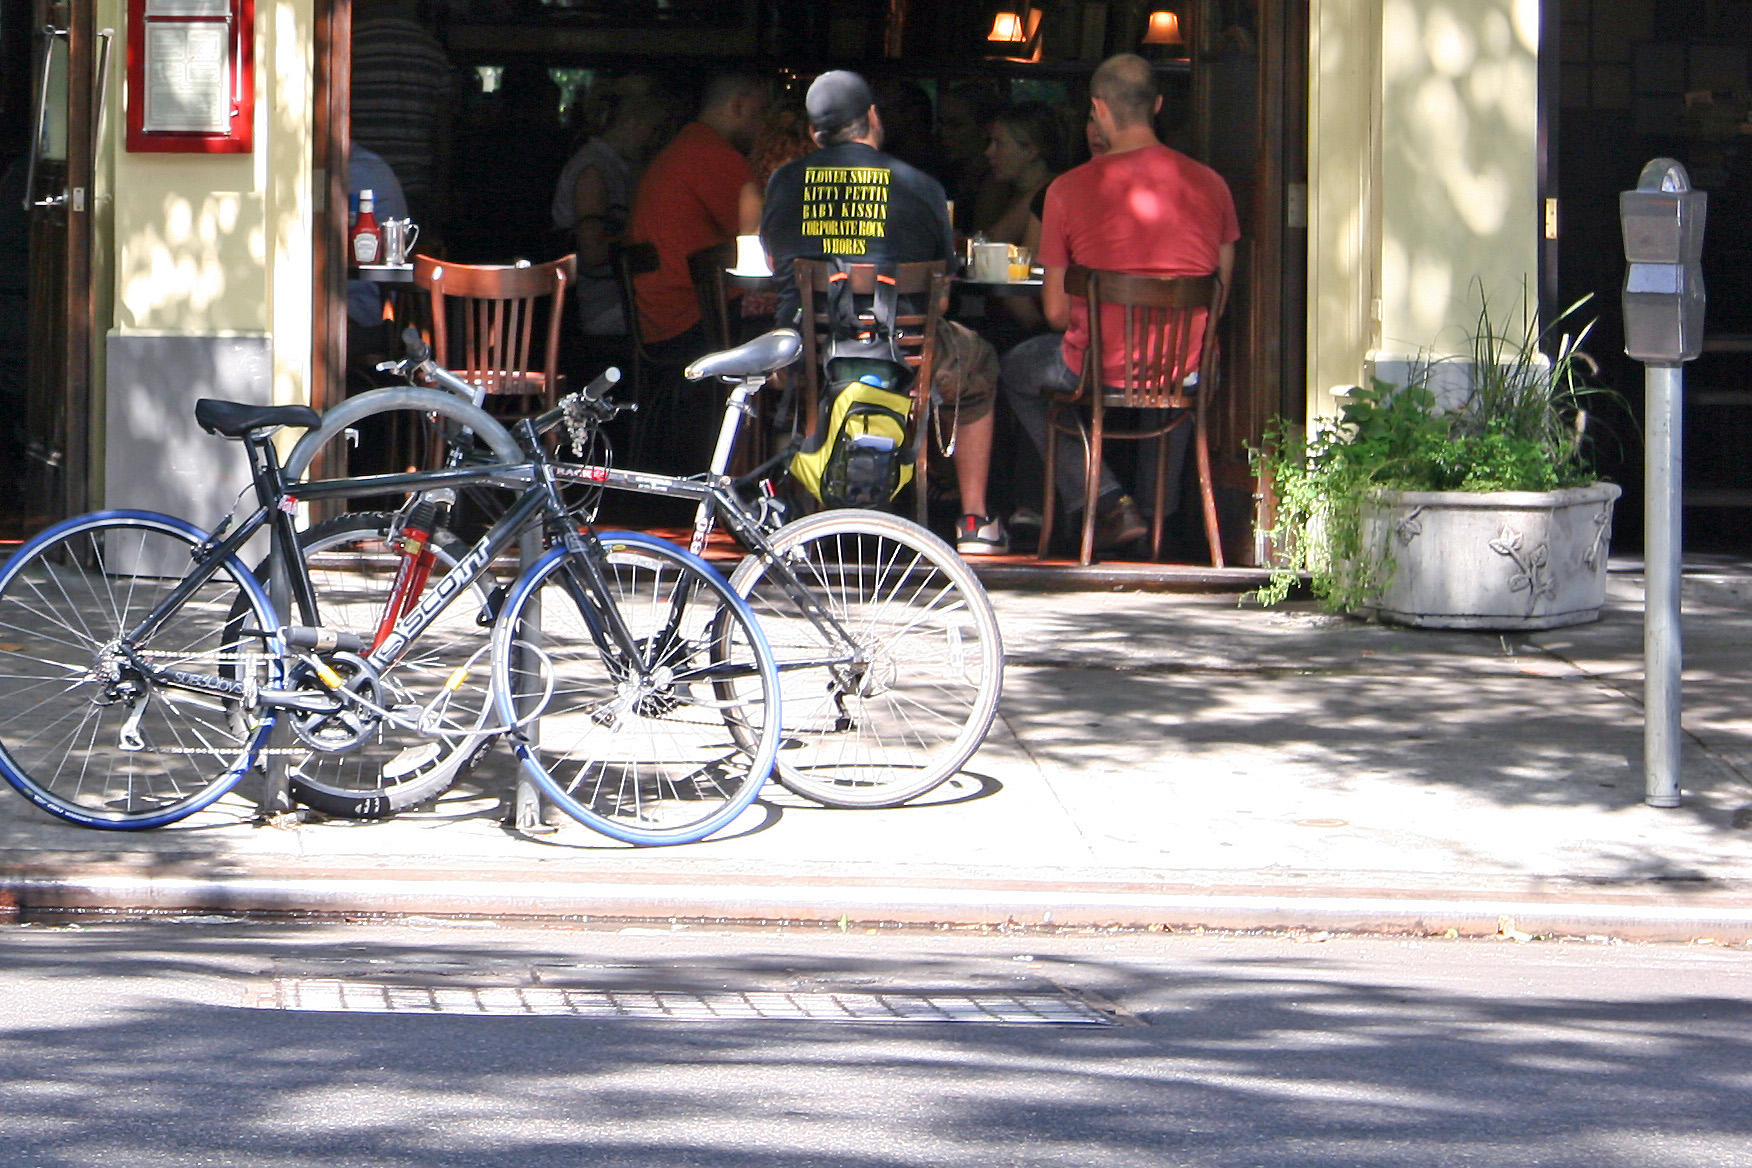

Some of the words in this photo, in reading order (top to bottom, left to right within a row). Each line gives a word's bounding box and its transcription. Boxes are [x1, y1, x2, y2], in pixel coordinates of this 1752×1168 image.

[805, 170, 848, 184] FLOWER
[850, 170, 890, 185] SNIFFIN
[803, 186, 838, 201] KITTY
[845, 186, 888, 202] PETTIN
[802, 204, 833, 219] BABY
[841, 202, 887, 220] KISSIN
[801, 220, 857, 236] CORPORATE
[858, 221, 885, 238] ROCK
[822, 238, 867, 255] WHORES
[399, 535, 491, 640] SCOTT
